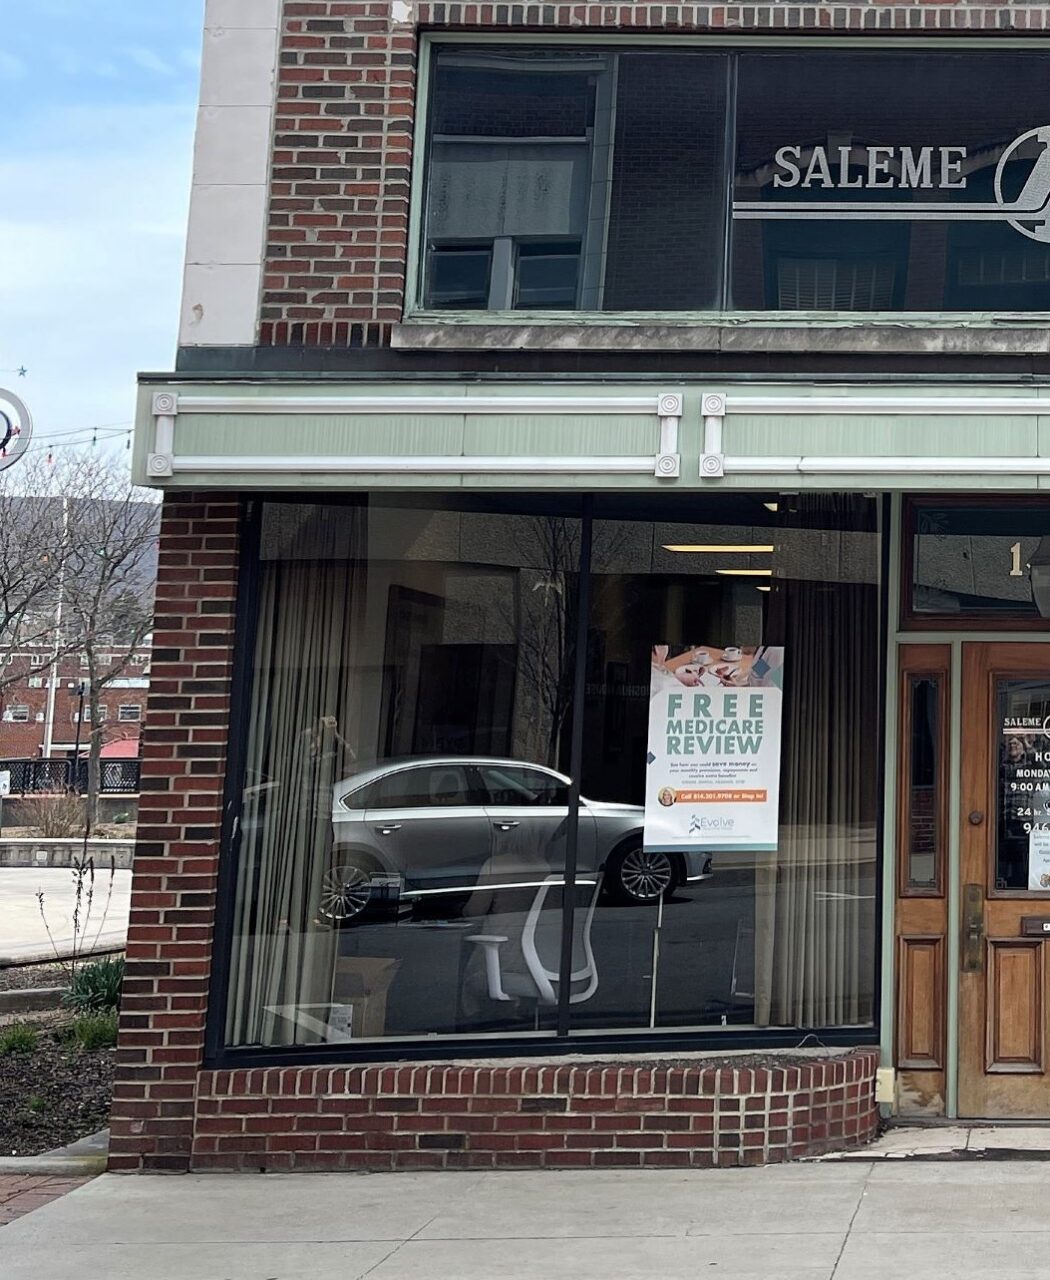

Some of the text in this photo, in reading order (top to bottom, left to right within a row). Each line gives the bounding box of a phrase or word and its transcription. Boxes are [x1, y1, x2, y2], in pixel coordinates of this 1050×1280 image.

[773, 145, 967, 189] SALEME
[667, 693, 764, 718] FREE
[666, 719, 764, 735] MEDICARE
[1004, 717, 1042, 727] SALEME
[666, 735, 763, 755] REVIEW
[1010, 782, 1033, 791] 9:00
[1017, 807, 1032, 816] 24
[700, 816, 735, 827] Evolve
